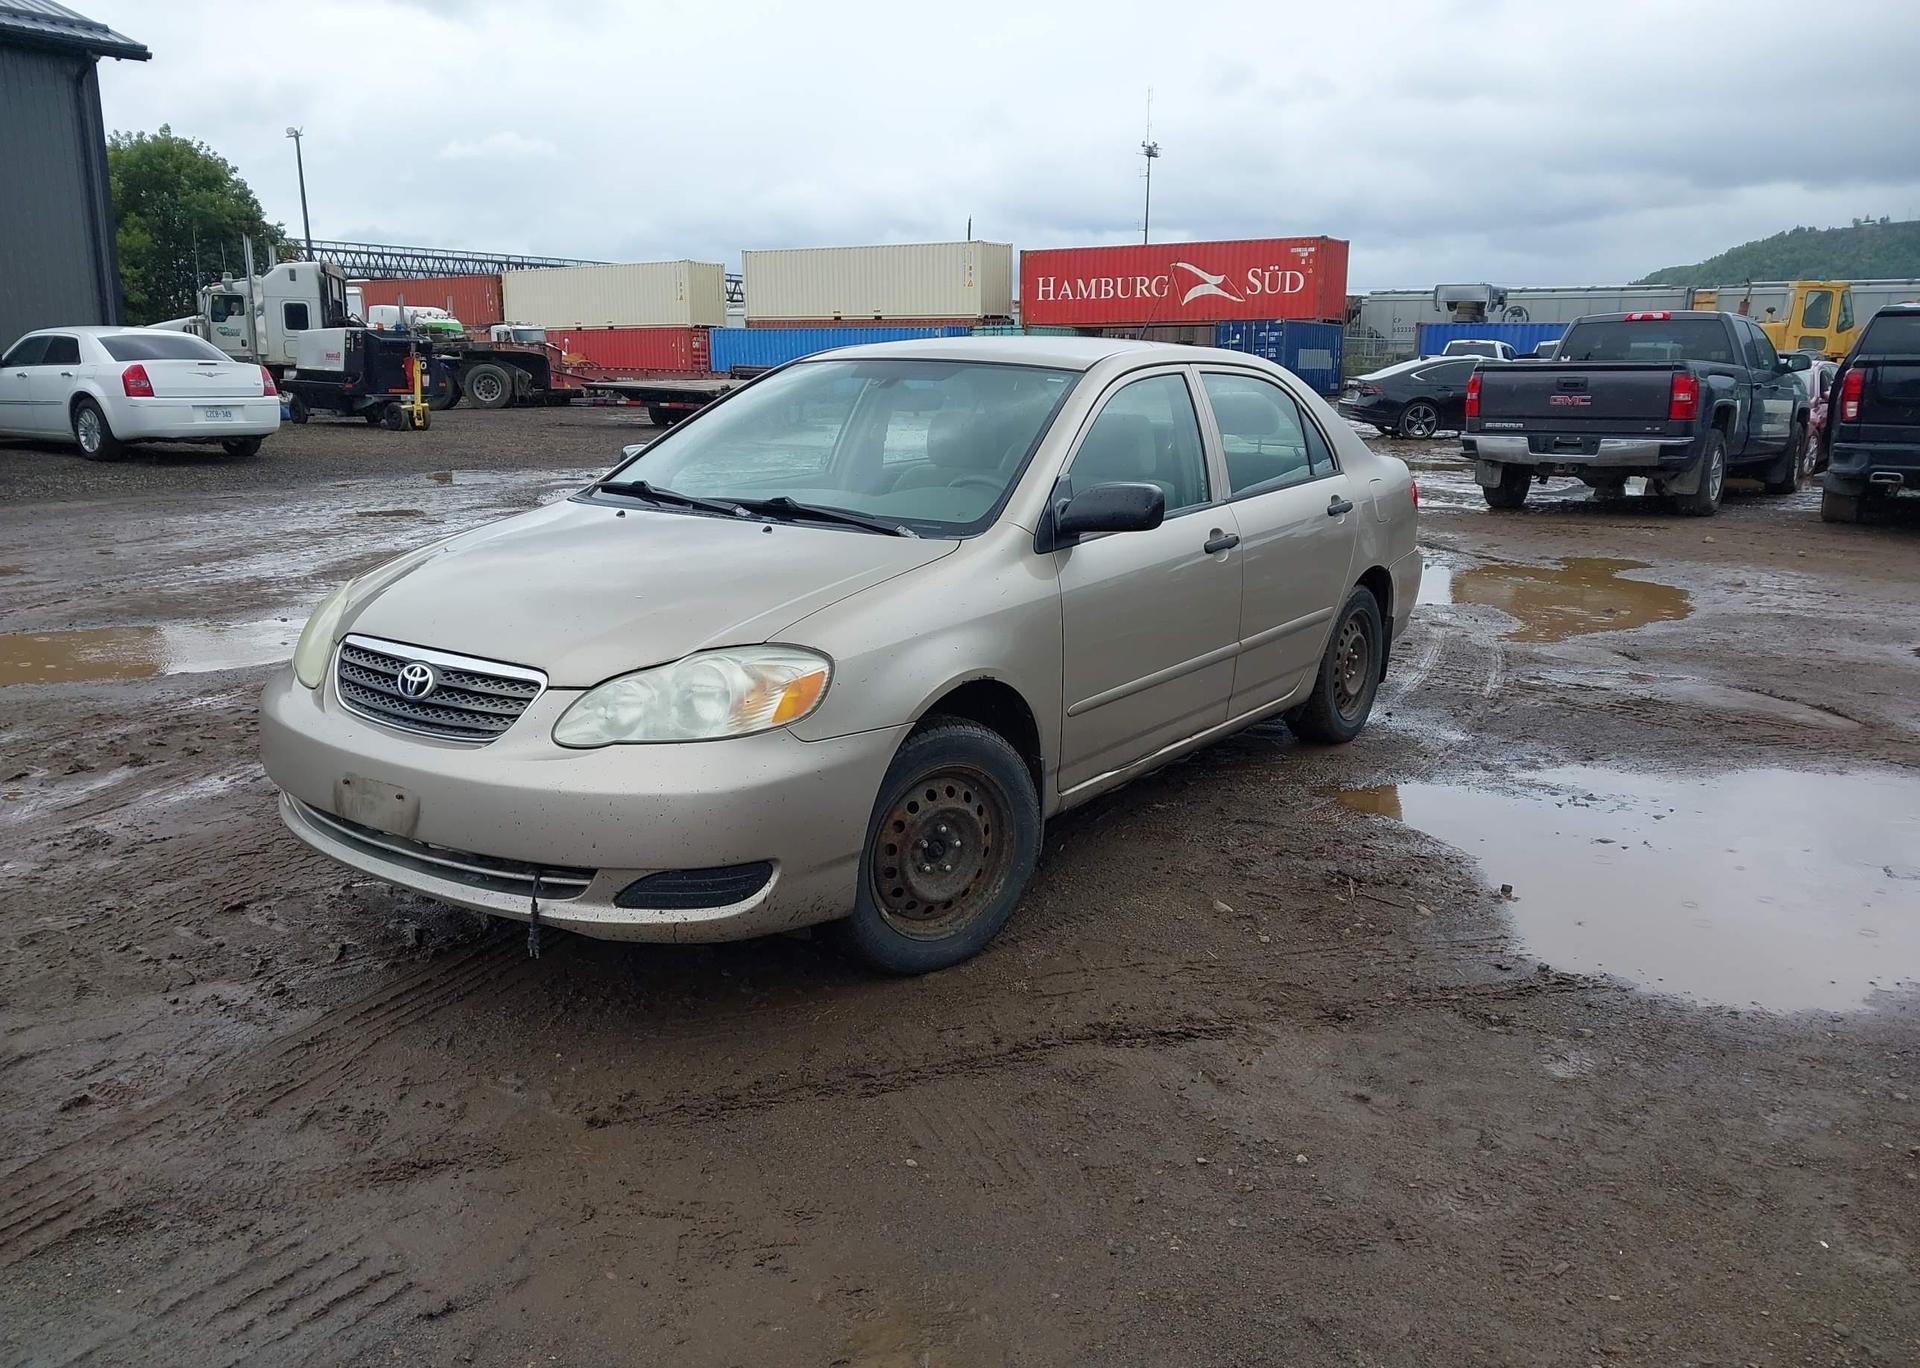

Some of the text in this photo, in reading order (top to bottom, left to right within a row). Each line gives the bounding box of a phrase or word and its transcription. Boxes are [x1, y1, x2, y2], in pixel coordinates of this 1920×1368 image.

[1037, 265, 1305, 300] HAMBURG SÜD
[1550, 395, 1592, 405] GMC
